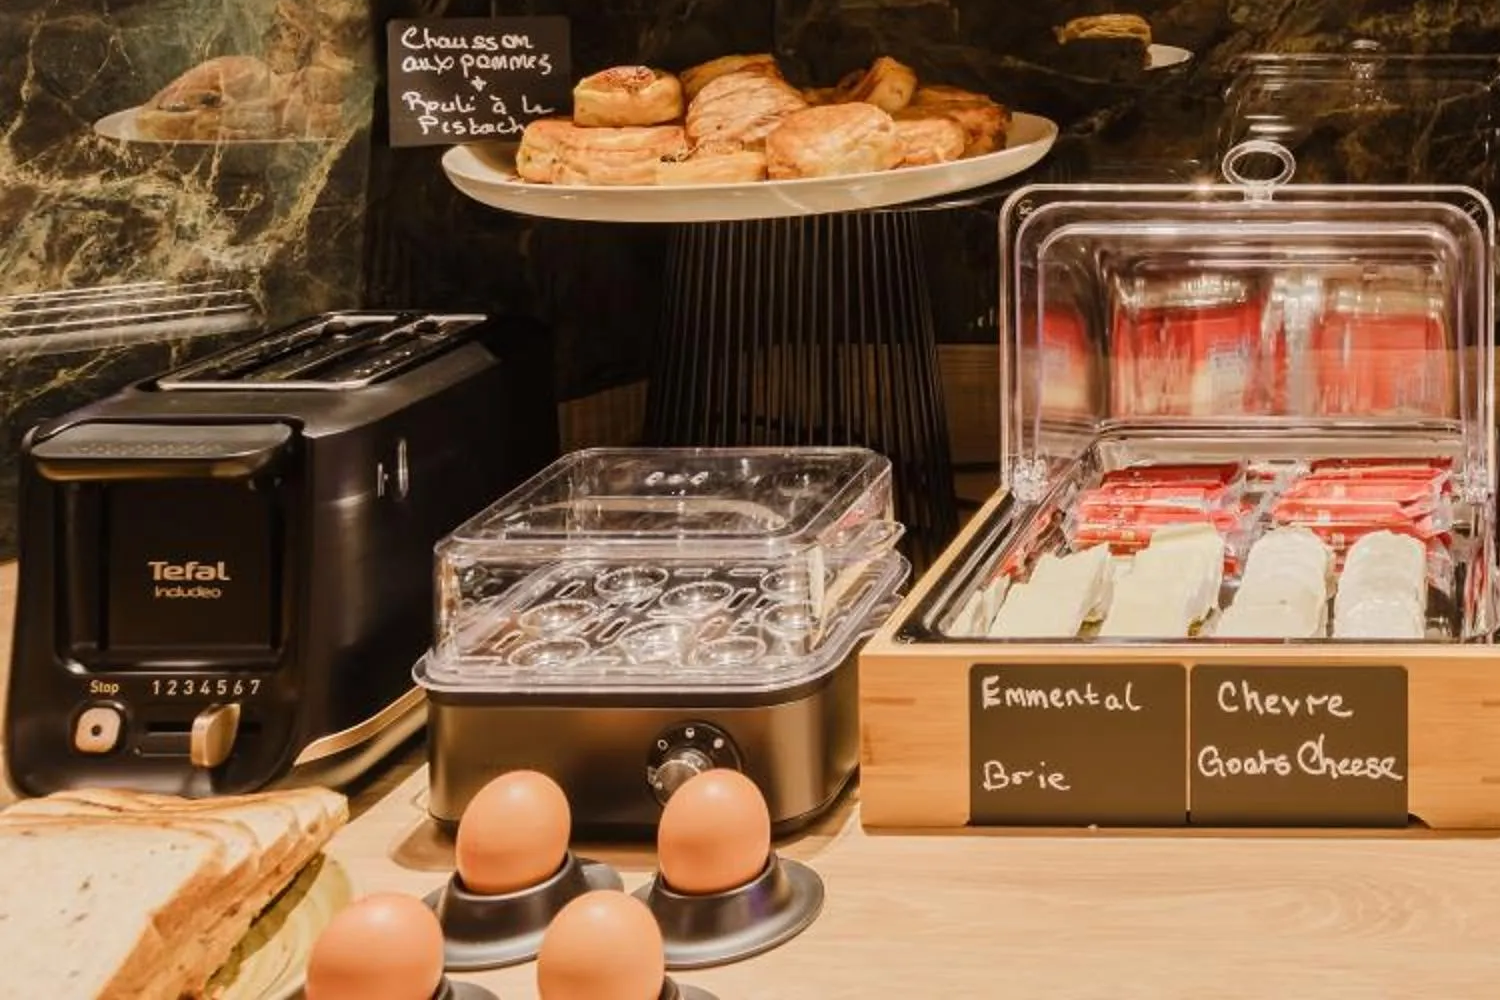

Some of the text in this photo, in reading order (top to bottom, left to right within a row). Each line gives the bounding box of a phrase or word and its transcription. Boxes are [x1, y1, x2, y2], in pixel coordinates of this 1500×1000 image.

[400, 25, 535, 51] Chausson
[401, 52, 552, 79] aux pommes
[416, 114, 527, 136] Pistach
[147, 561, 232, 582] Tefal
[89, 679, 121, 694] Stop
[152, 679, 262, 696] 1 2 3 4 5 6 7
[981, 674, 1143, 712] Emmental
[1217, 680, 1355, 719] Chevre
[1296, 732, 1405, 781] Cheese
[982, 759, 1072, 792] Brie
